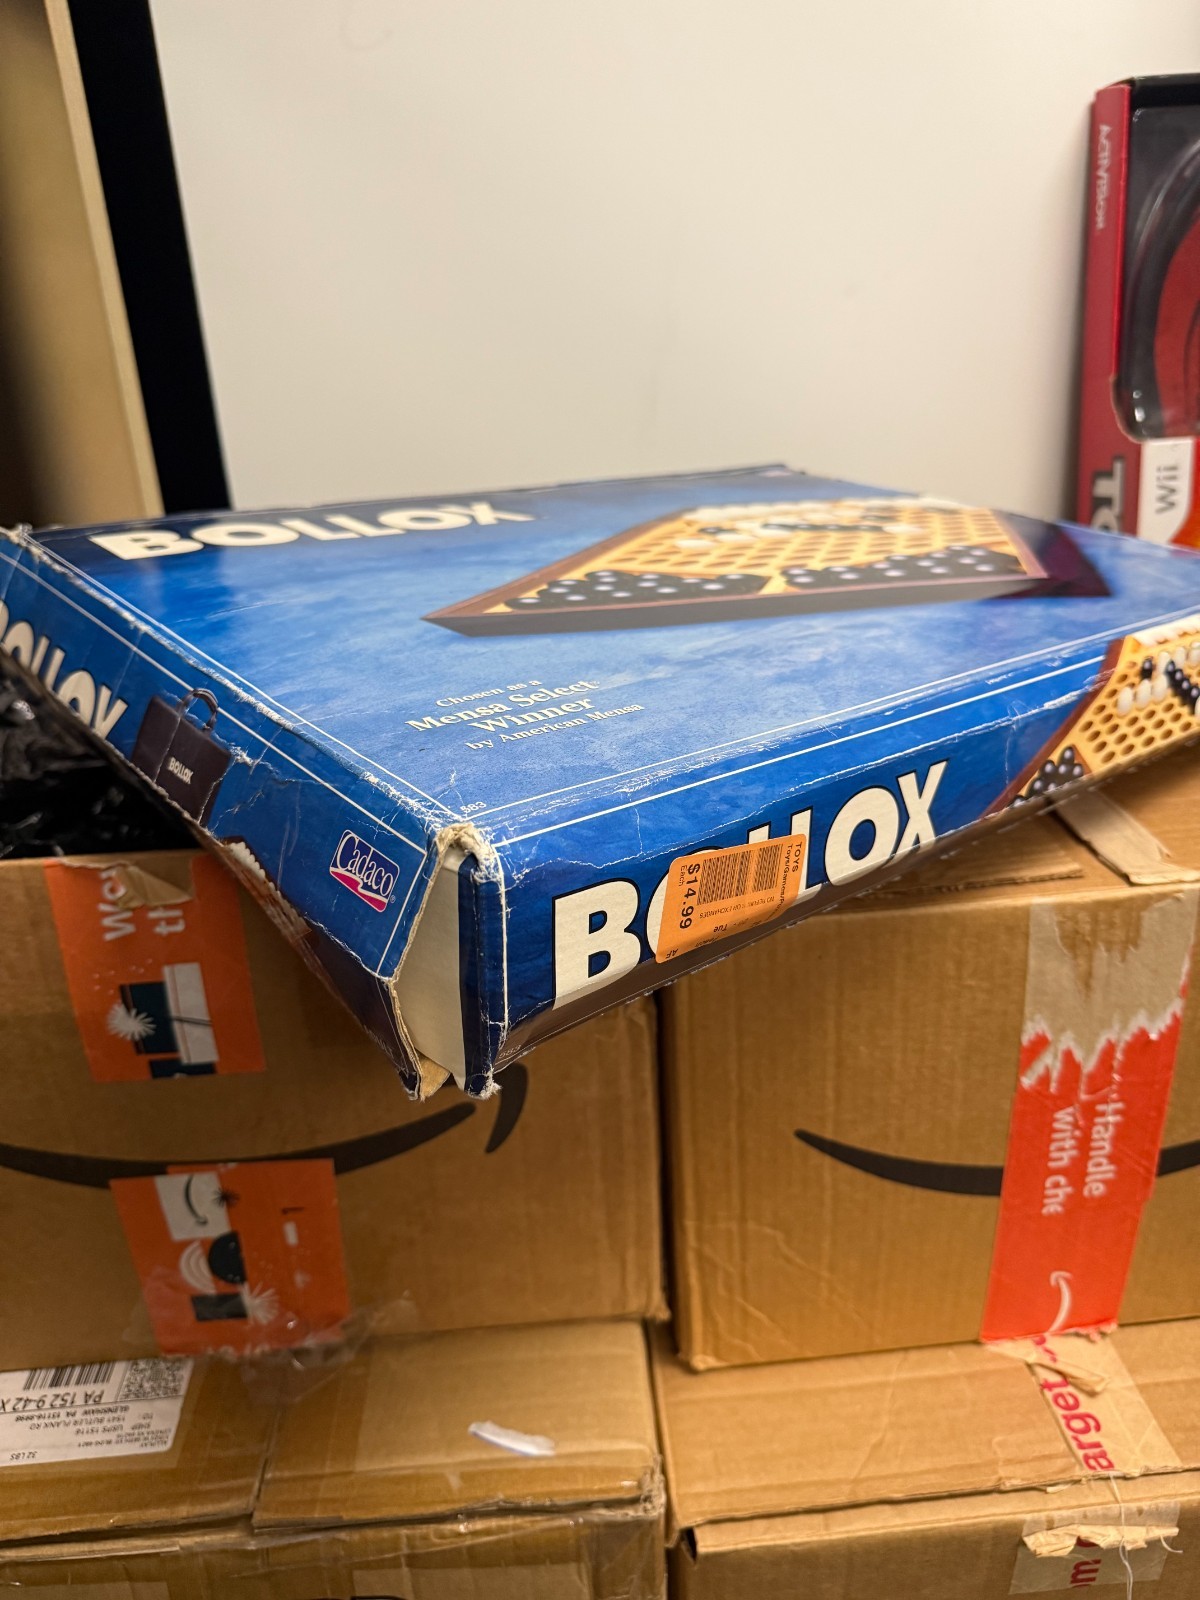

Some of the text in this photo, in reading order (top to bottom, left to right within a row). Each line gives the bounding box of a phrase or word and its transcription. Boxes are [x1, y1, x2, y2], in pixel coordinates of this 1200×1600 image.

[1155, 465, 1179, 515] Wii
[89, 502, 535, 560] BOLLOX
[436, 679, 543, 708] Chosen as a
[405, 701, 513, 731] Mensa
[465, 703, 645, 751] by American Mensa
[467, 698, 595, 732] Winner
[168, 756, 194, 785] BOLLOX
[792, 842, 803, 873] TOYS
[678, 865, 688, 887] Each
[680, 863, 700, 929] $14.99
[1048, 1106, 1080, 1168] with
[1083, 1102, 1124, 1197] Handle
[84, 1389, 105, 1404] PA
